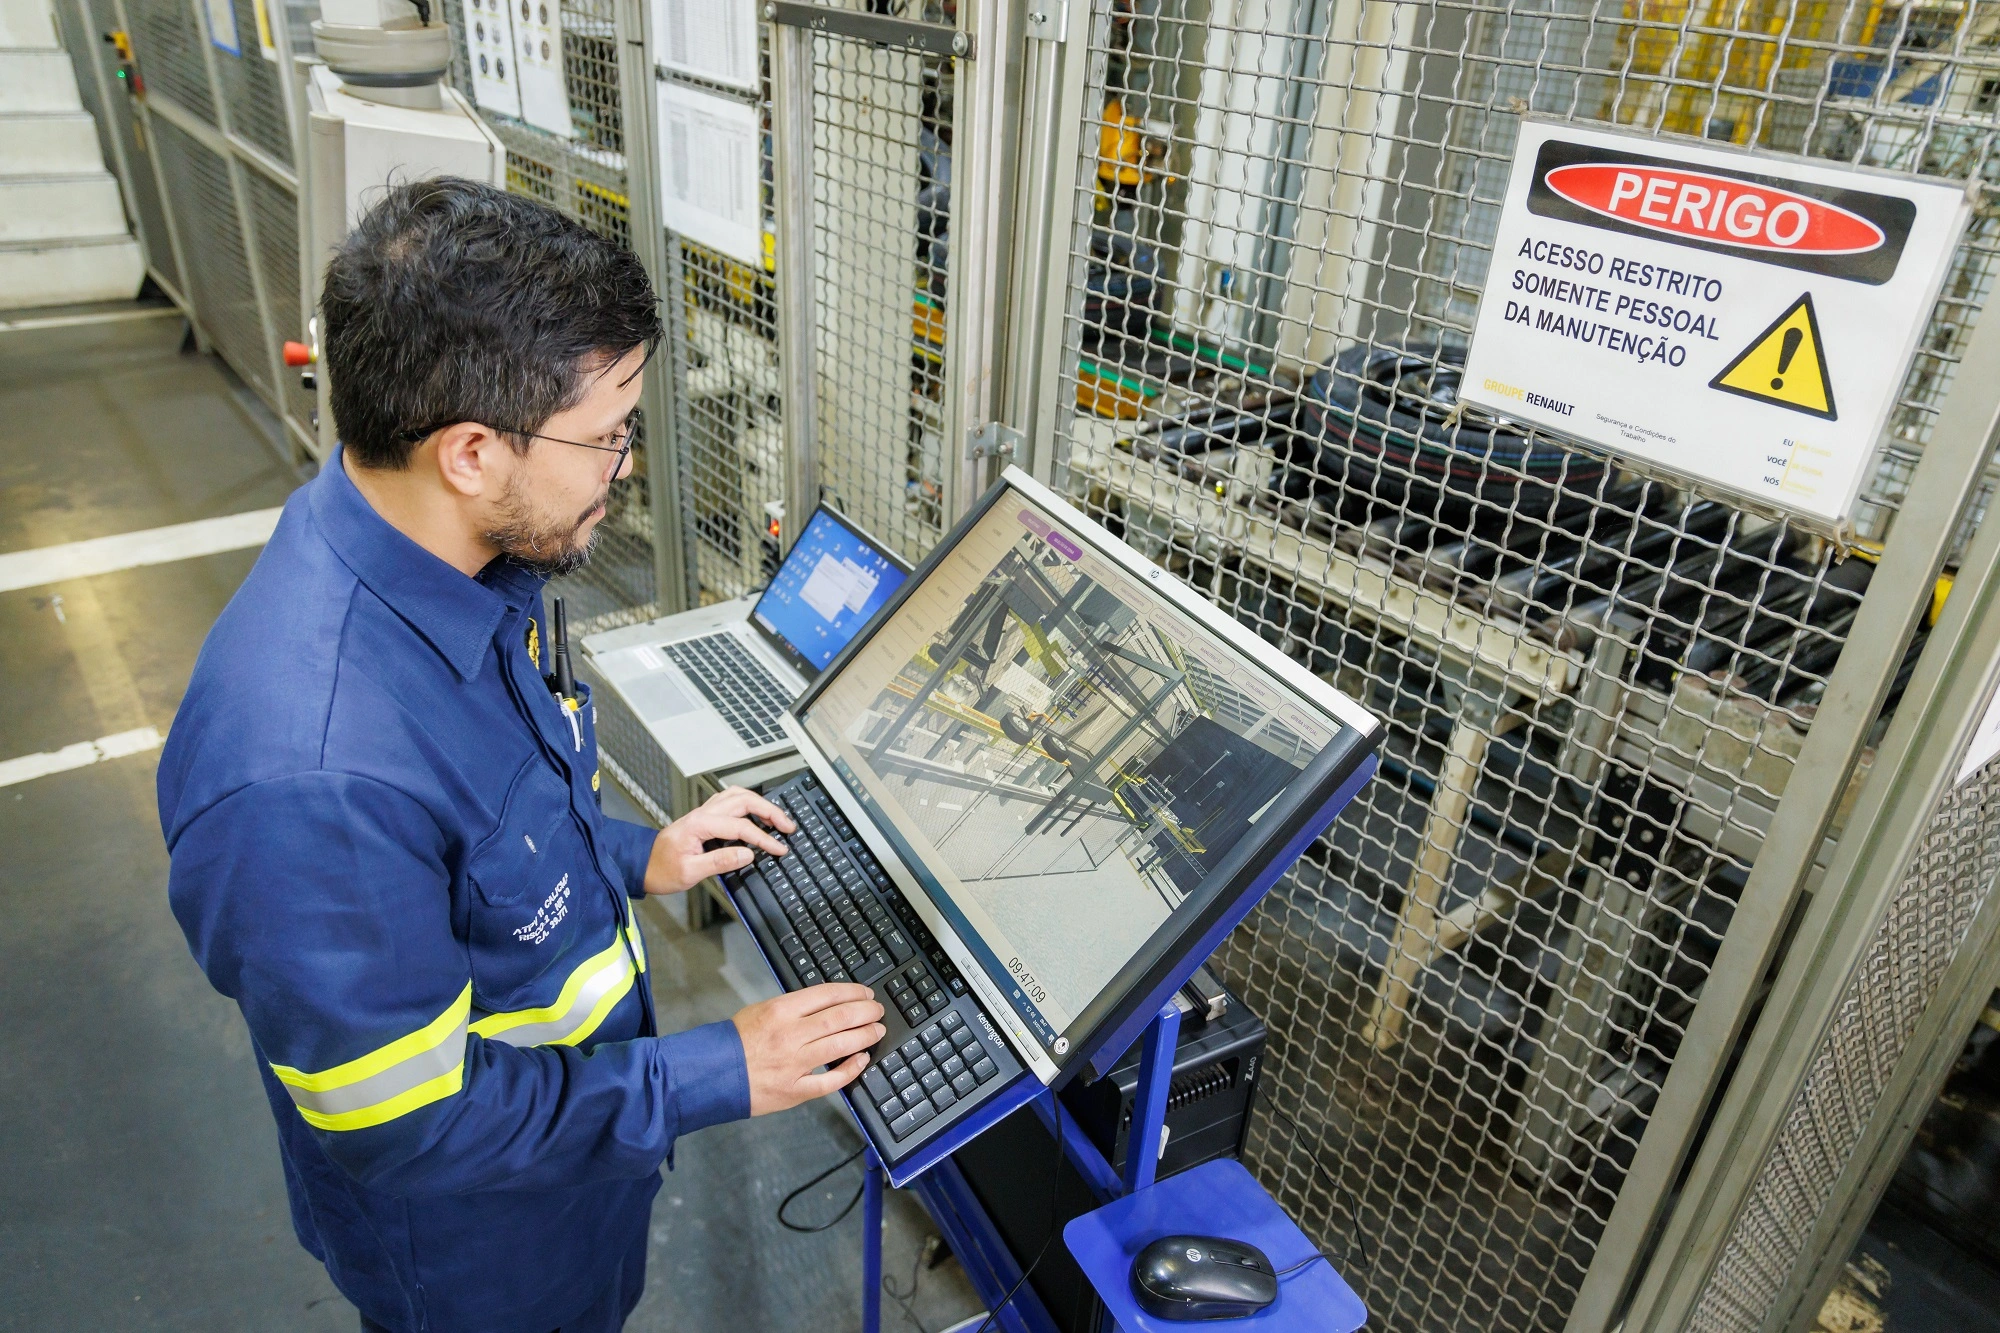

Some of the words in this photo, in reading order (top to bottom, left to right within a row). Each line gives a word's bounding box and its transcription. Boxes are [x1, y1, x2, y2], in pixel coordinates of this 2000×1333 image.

[1607, 171, 1810, 247] PERIGO
[1518, 237, 1604, 275] ACESSO
[1609, 257, 1723, 302] RESTRITO
[1512, 269, 1612, 312] SOMENTE
[1614, 295, 1720, 341] PESSOAL
[1504, 300, 1530, 327] DA
[1535, 309, 1687, 367] MANUTENÇÃO
[1483, 378, 1525, 400] GROUPE
[1526, 392, 1575, 416] RENAULT
[1596, 414, 1627, 428] Segurança
[1634, 426, 1666, 440] Condições
[1620, 430, 1646, 442] Trabalho
[1782, 438, 1794, 446] EU
[1767, 456, 1787, 467] VOCÊ
[1763, 476, 1780, 486] NÓS
[1008, 957, 1046, 1003] 09:47:09
[976, 1012, 1005, 1049] Kensington
